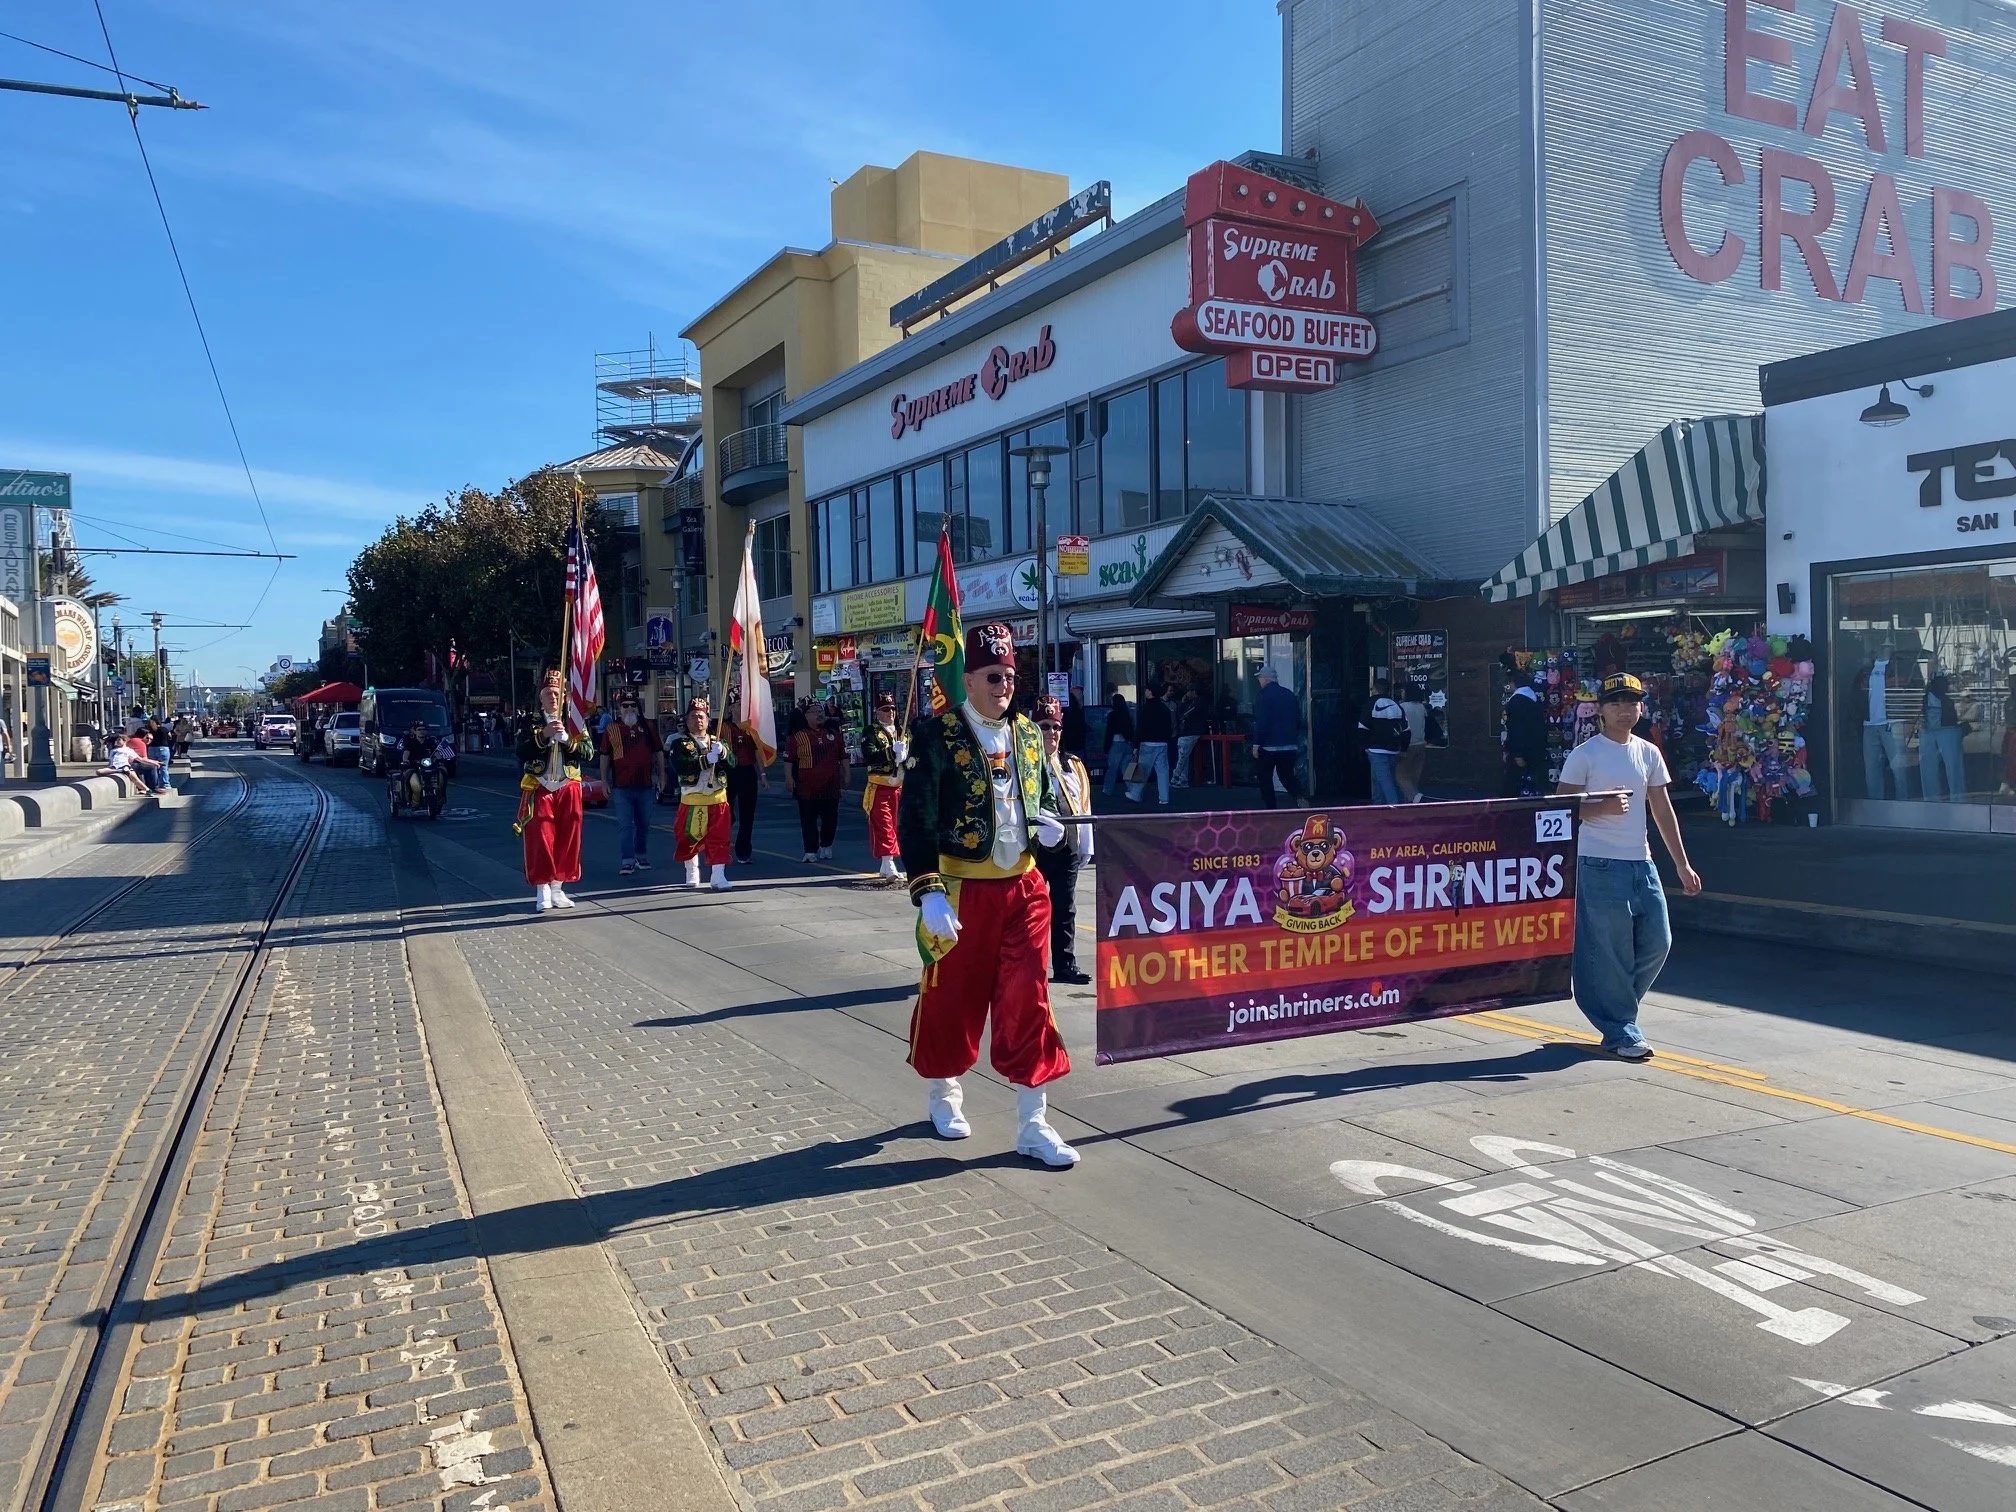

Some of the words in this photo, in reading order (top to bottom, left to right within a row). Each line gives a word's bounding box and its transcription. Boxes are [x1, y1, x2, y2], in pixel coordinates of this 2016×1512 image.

[1723, 0, 1947, 159] EAT
[1659, 128, 1998, 321] CRAB
[1204, 305, 1295, 342] SEAFOOD
[1304, 318, 1372, 350] BUFFET
[1256, 354, 1331, 381] OPEN
[1956, 512, 1999, 532] SAN
[864, 585, 899, 599] ACCESSORIES
[1410, 674, 1428, 682] TOGO
[1542, 817, 1563, 838] 22
[1370, 846, 1394, 860] BAY
[1395, 844, 1430, 860] AREA,
[1432, 840, 1497, 855] CALIFORNIA
[1192, 856, 1228, 871] SINCE
[1231, 854, 1261, 868] 1883
[1108, 876, 1263, 937] ASIYA
[1286, 918, 1316, 930] GIVING
[1318, 915, 1342, 929] BACK
[1109, 943, 1250, 989] MOTHER
[1260, 930, 1374, 971] TEMPLE
[1384, 925, 1422, 957] OF
[1433, 920, 1484, 952] THE
[1494, 911, 1565, 946] WEST
[1226, 986, 1400, 1033] joinshriners.com
